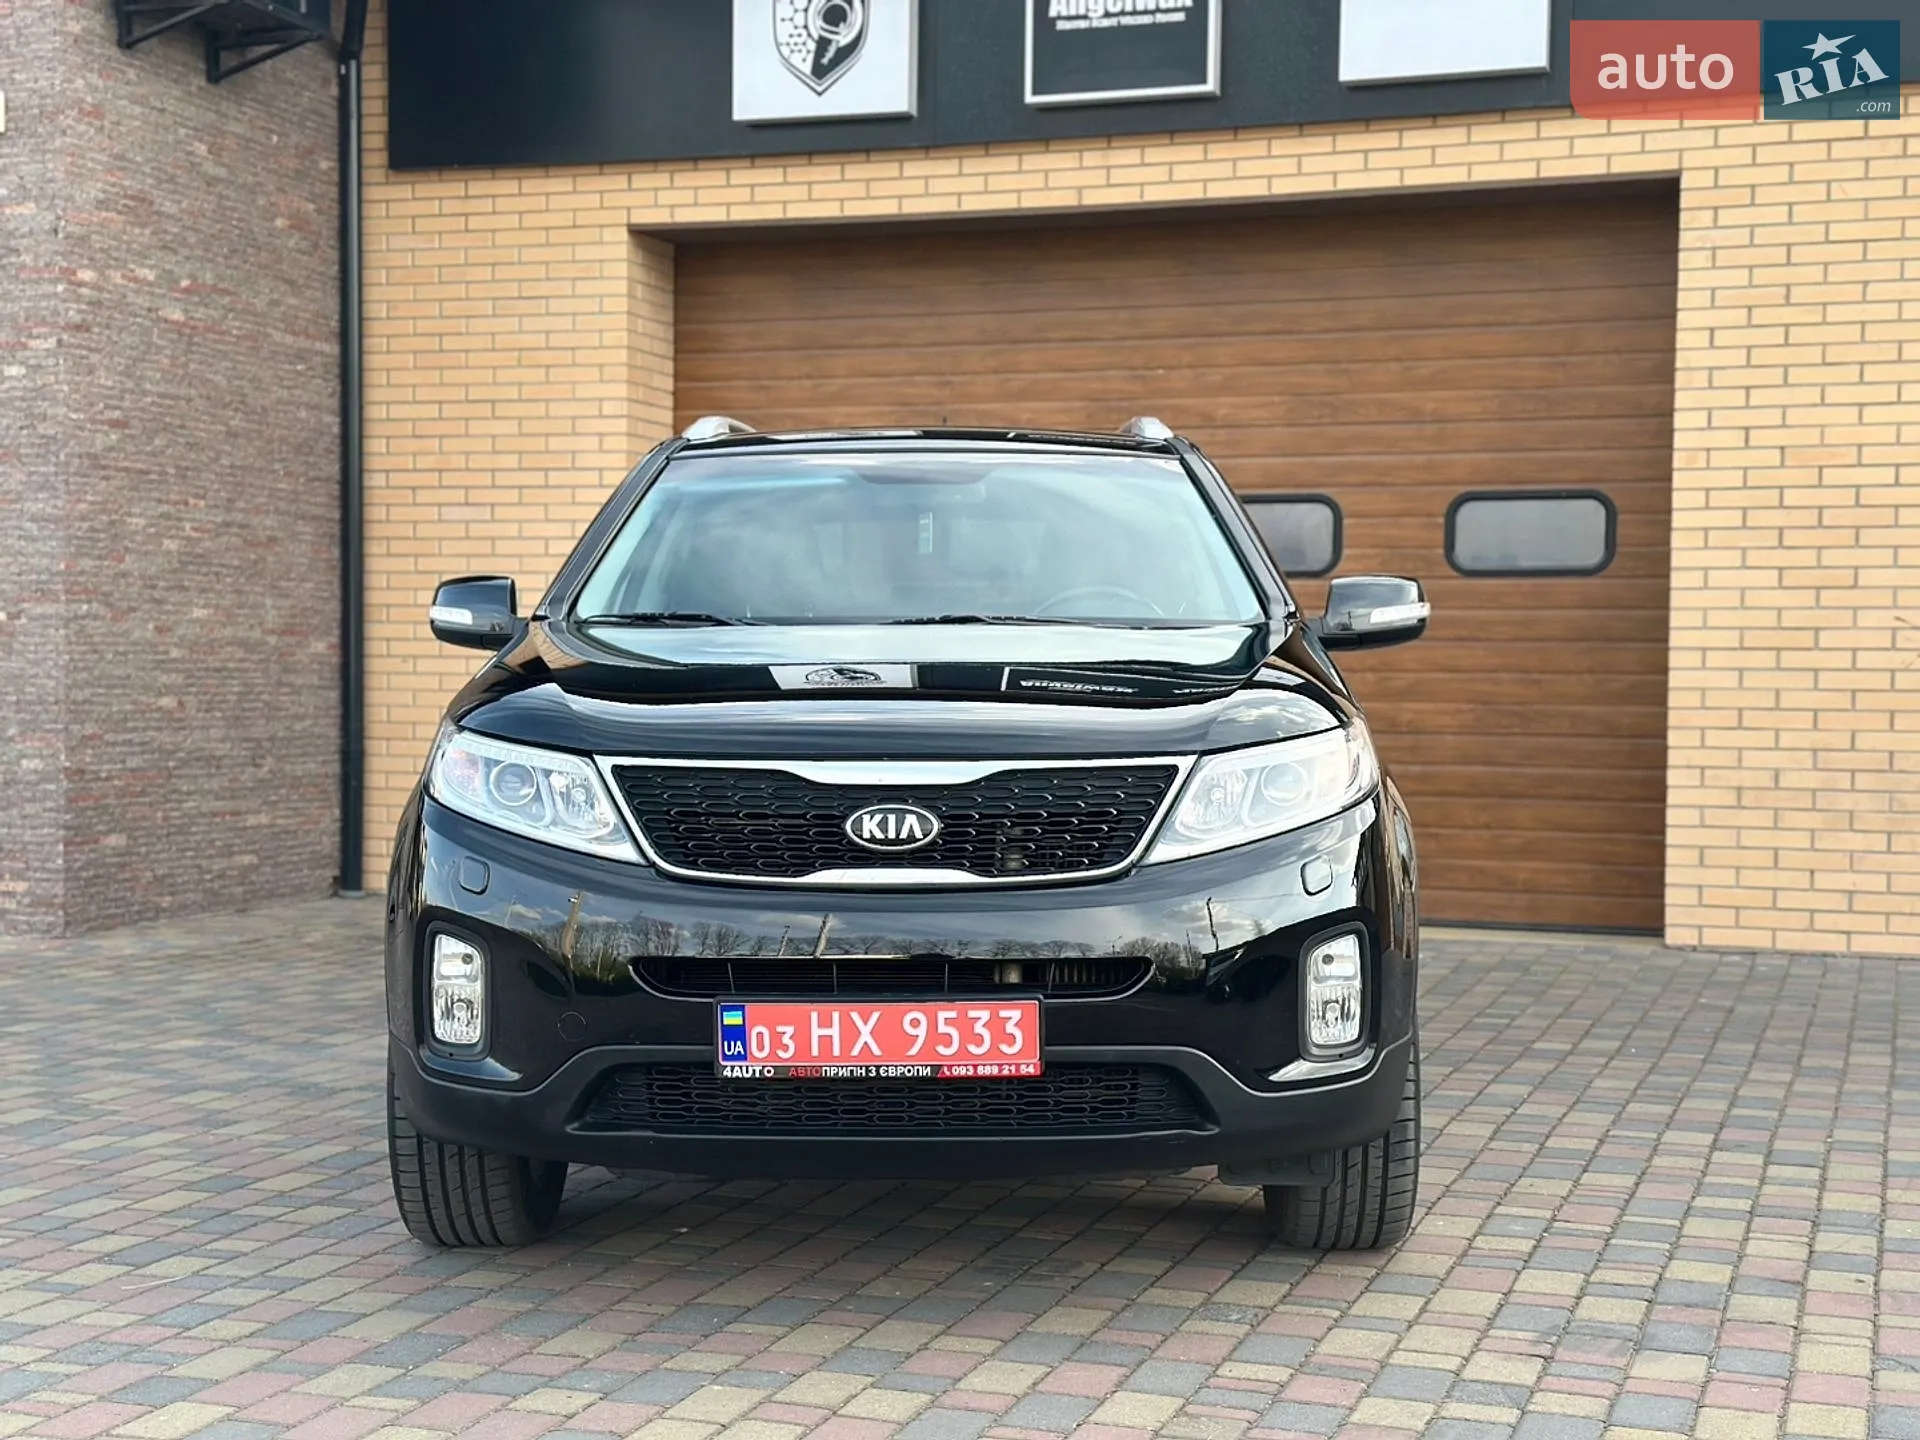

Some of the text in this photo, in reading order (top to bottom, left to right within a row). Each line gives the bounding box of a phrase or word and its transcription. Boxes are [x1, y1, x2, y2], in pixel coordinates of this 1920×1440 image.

[861, 813, 924, 839] KIA
[750, 1010, 1024, 1059] 03 HX 9533
[724, 1040, 745, 1056] UA
[722, 1067, 775, 1078] 4AUTO
[879, 1066, 931, 1077] ЄВРОПИ
[951, 1065, 974, 1076] 093
[1001, 1064, 1016, 1074] 21
